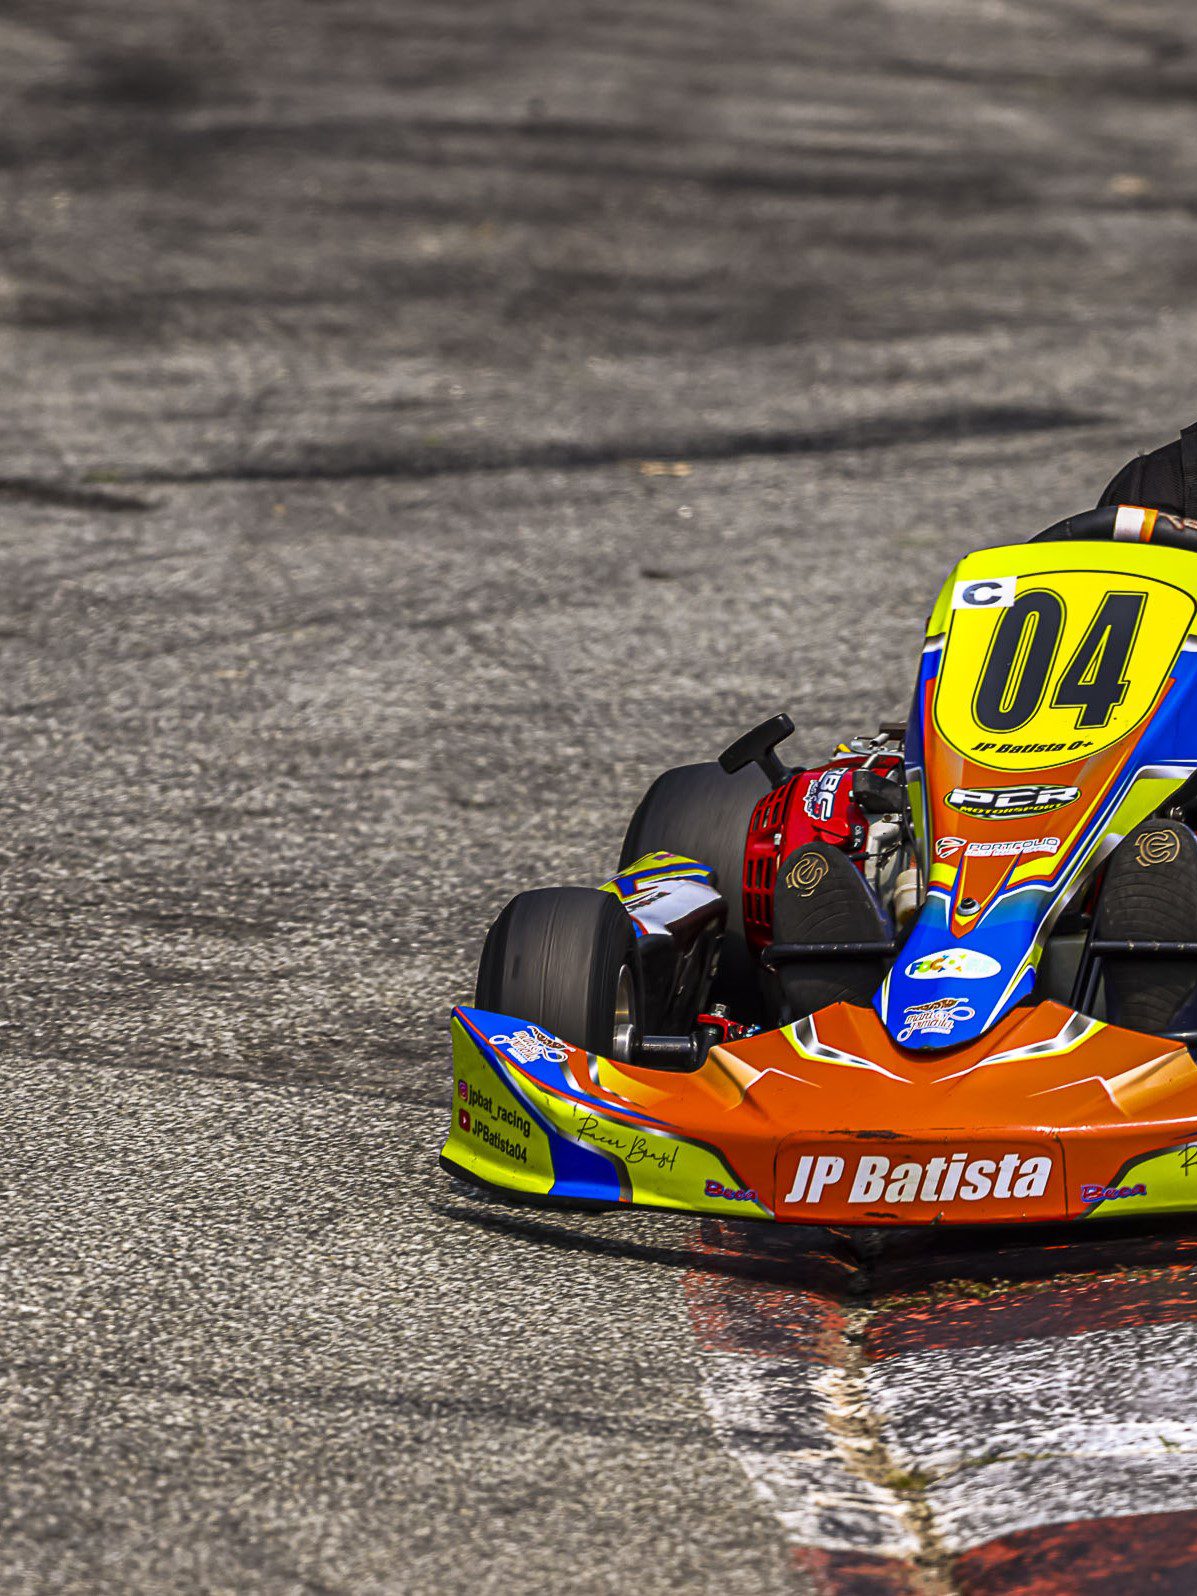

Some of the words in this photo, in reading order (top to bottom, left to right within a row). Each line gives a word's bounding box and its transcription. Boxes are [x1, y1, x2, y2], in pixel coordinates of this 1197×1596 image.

[962, 582, 1003, 606] C
[971, 587, 1149, 734] 04
[971, 742, 997, 752] JP
[995, 743, 1067, 753] Batista
[949, 787, 1079, 808] PCR
[960, 803, 1063, 815] MOTORSPORT
[969, 838, 1059, 851] PORTFOLIO
[468, 1084, 531, 1137] jpbat_racing
[472, 1122, 527, 1164] JPBatista04
[784, 1155, 845, 1203] JP
[848, 1152, 1053, 1203] Batista
